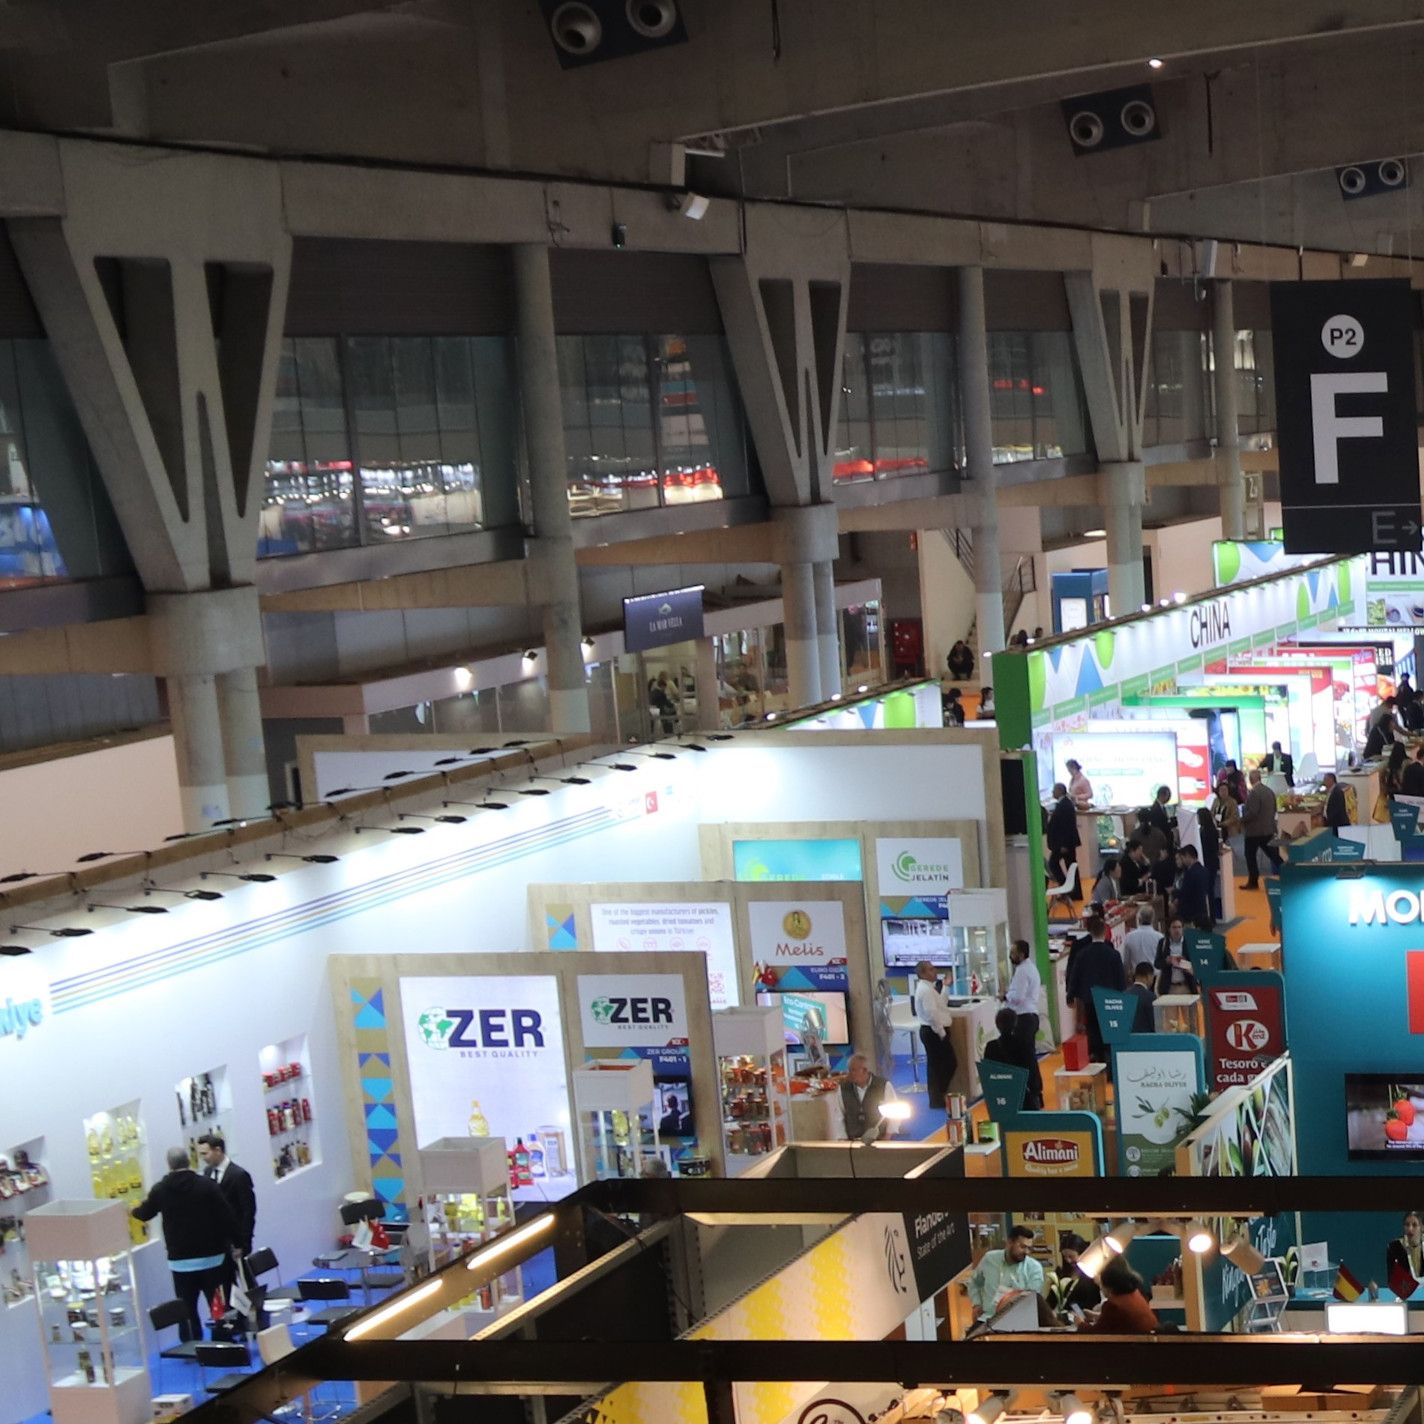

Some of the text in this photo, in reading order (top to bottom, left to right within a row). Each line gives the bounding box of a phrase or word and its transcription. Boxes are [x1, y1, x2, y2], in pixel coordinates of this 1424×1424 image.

[1327, 325, 1358, 348] P2
[1310, 373, 1388, 483] F
[1372, 511, 1397, 545] E
[1190, 601, 1232, 649] CHINA
[910, 864, 949, 872] GEREDE
[775, 943, 824, 957] Melis
[610, 998, 673, 1024] ZER
[446, 1008, 545, 1048] ZER
[461, 1050, 539, 1059] BEST QUALITY
[1219, 1058, 1259, 1069] Tesoro
[1217, 1073, 1245, 1083] cada
[1024, 1140, 1079, 1161] Alimani
